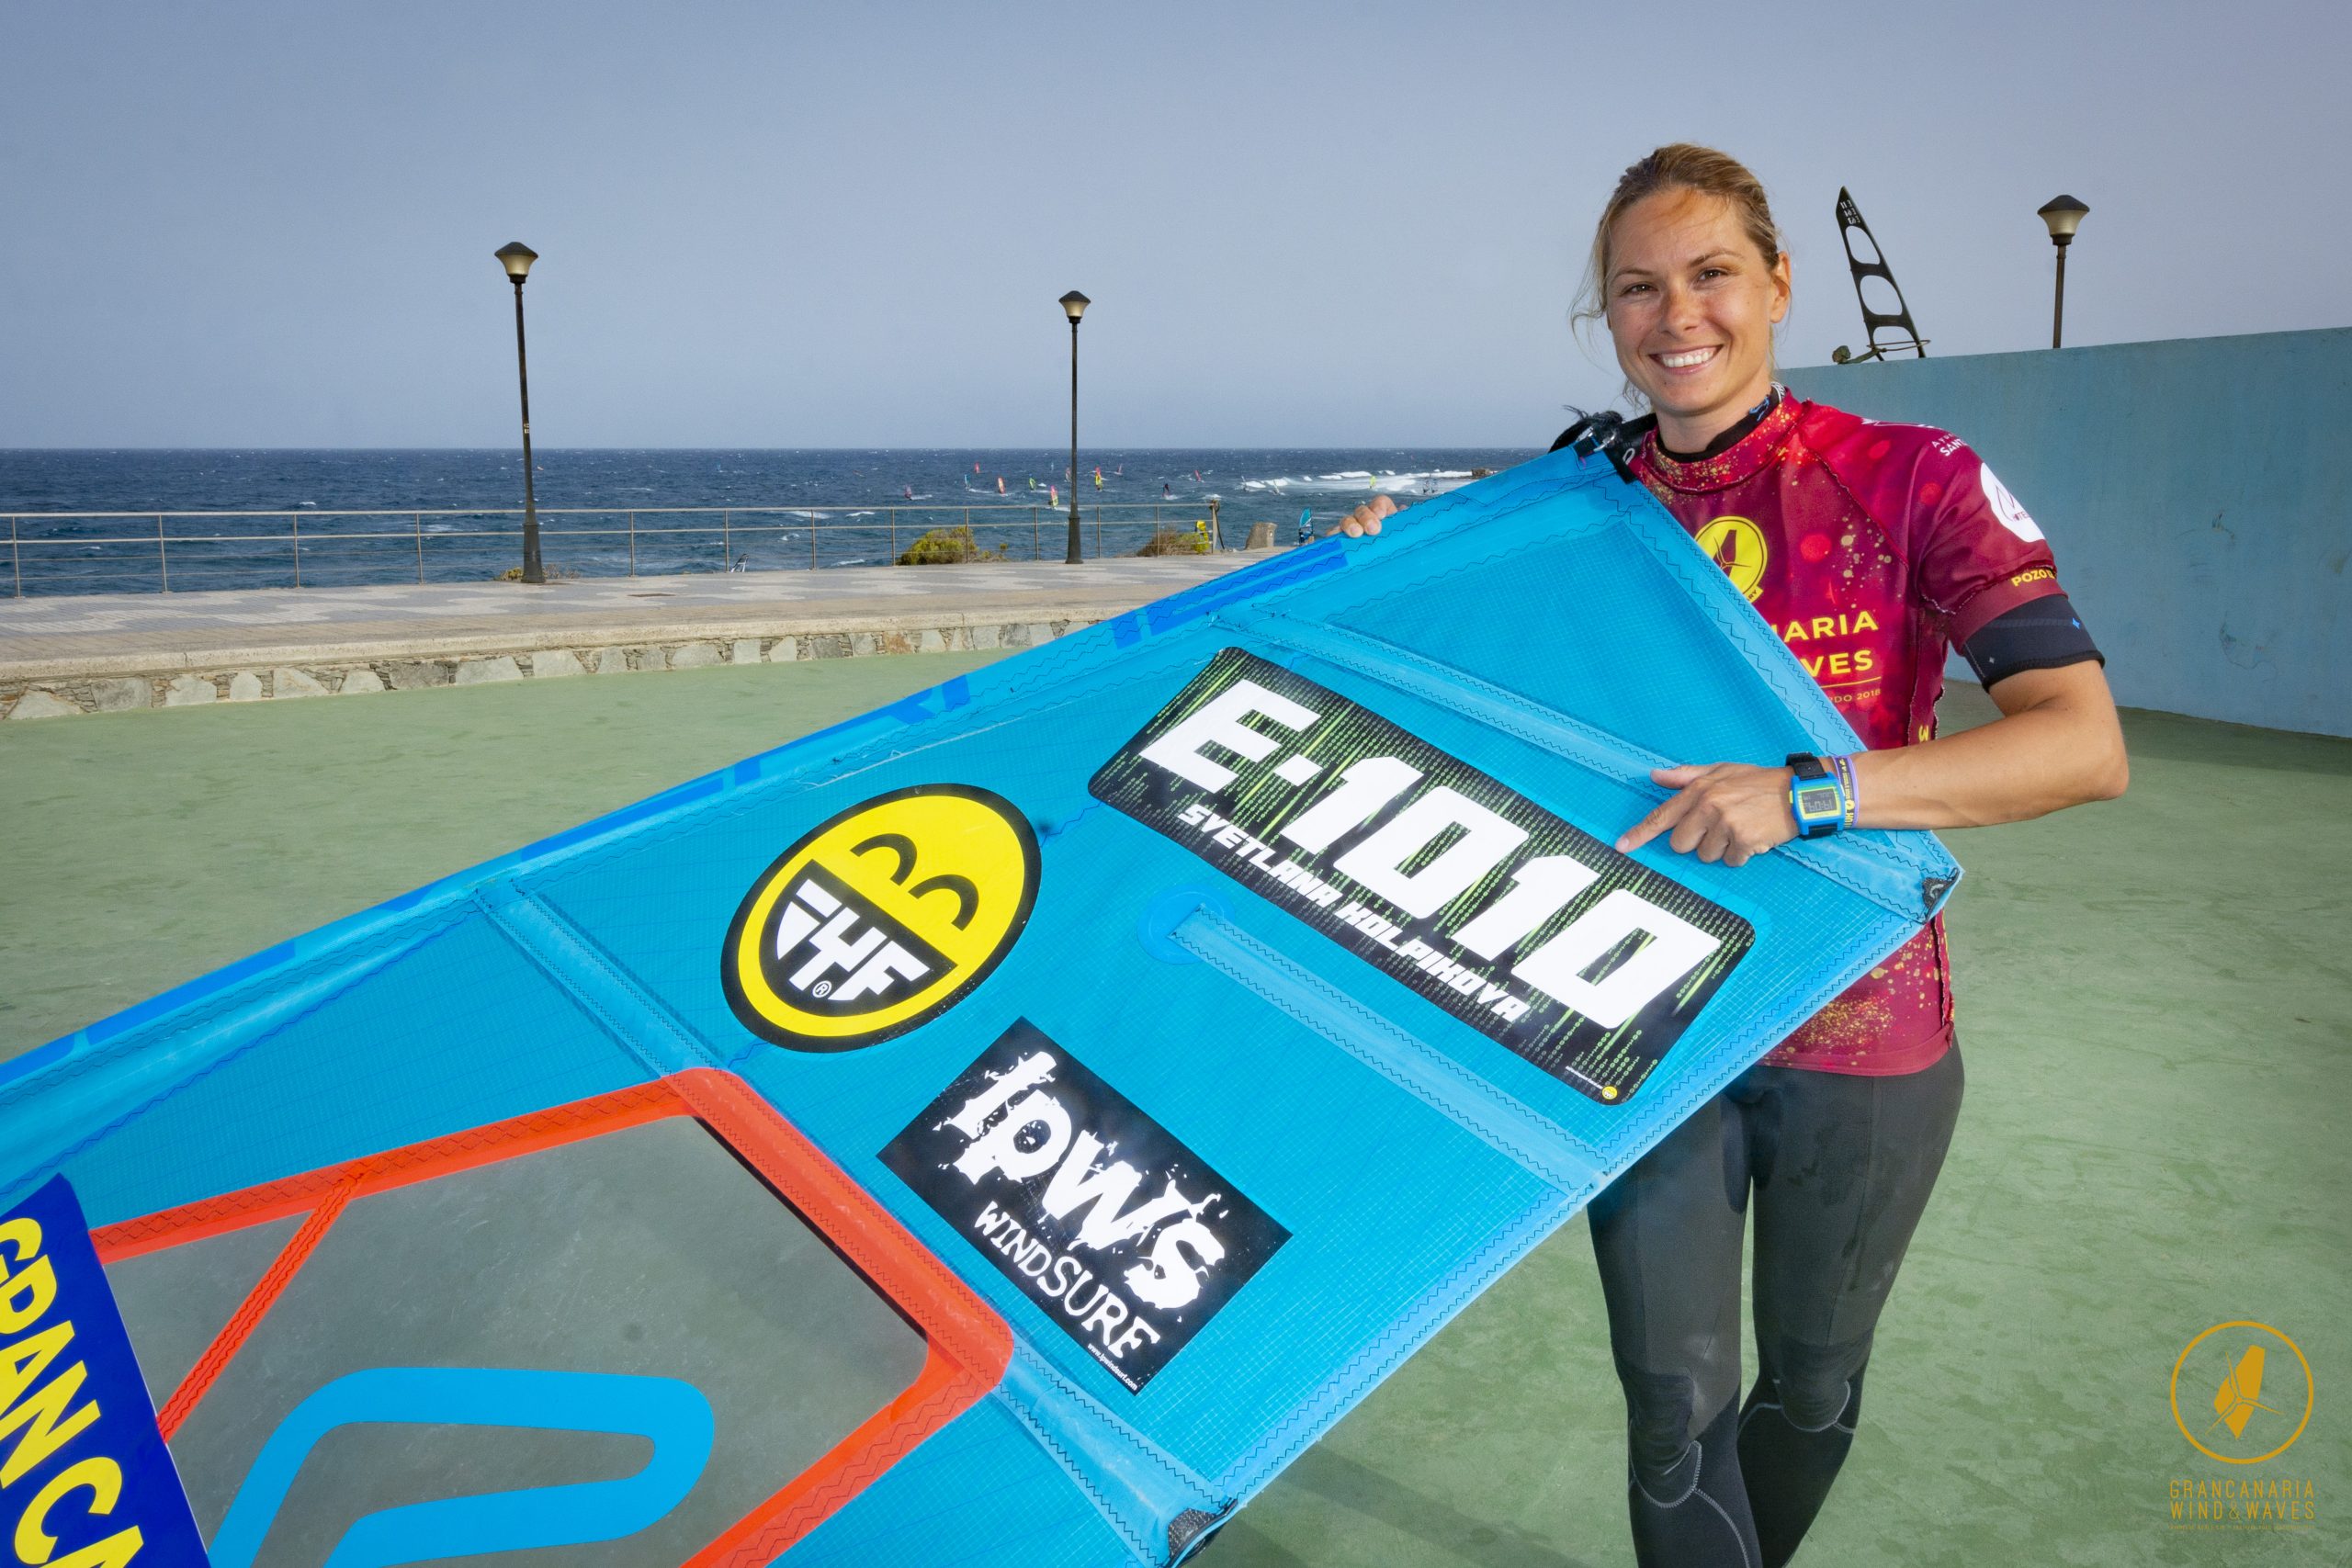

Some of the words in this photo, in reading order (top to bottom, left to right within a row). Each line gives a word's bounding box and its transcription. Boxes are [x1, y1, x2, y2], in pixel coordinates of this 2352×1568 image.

[2010, 569, 2048, 587] POZO
[1139, 679, 1722, 1029] E-1010
[1177, 804, 1343, 908] SVETLANA
[1334, 901, 1531, 1022] KOLPIKOVA
[974, 1201, 1161, 1359] WINDSURF
